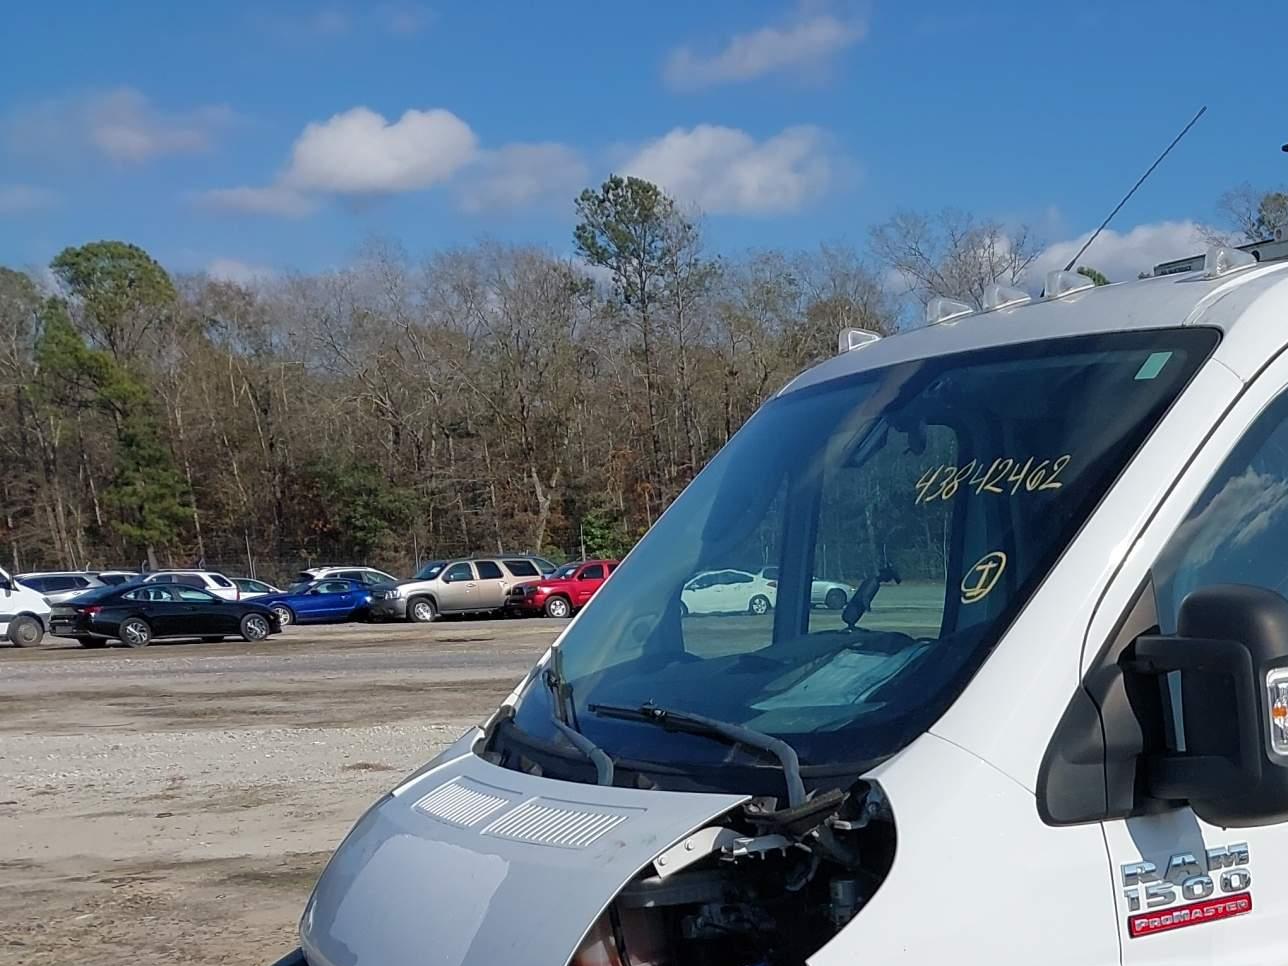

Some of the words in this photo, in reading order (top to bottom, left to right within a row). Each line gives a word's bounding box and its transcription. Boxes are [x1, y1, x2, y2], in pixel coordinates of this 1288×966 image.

[914, 454, 1072, 505] 43842462
[1120, 842, 1249, 887] RAM
[1124, 868, 1251, 911] 1500
